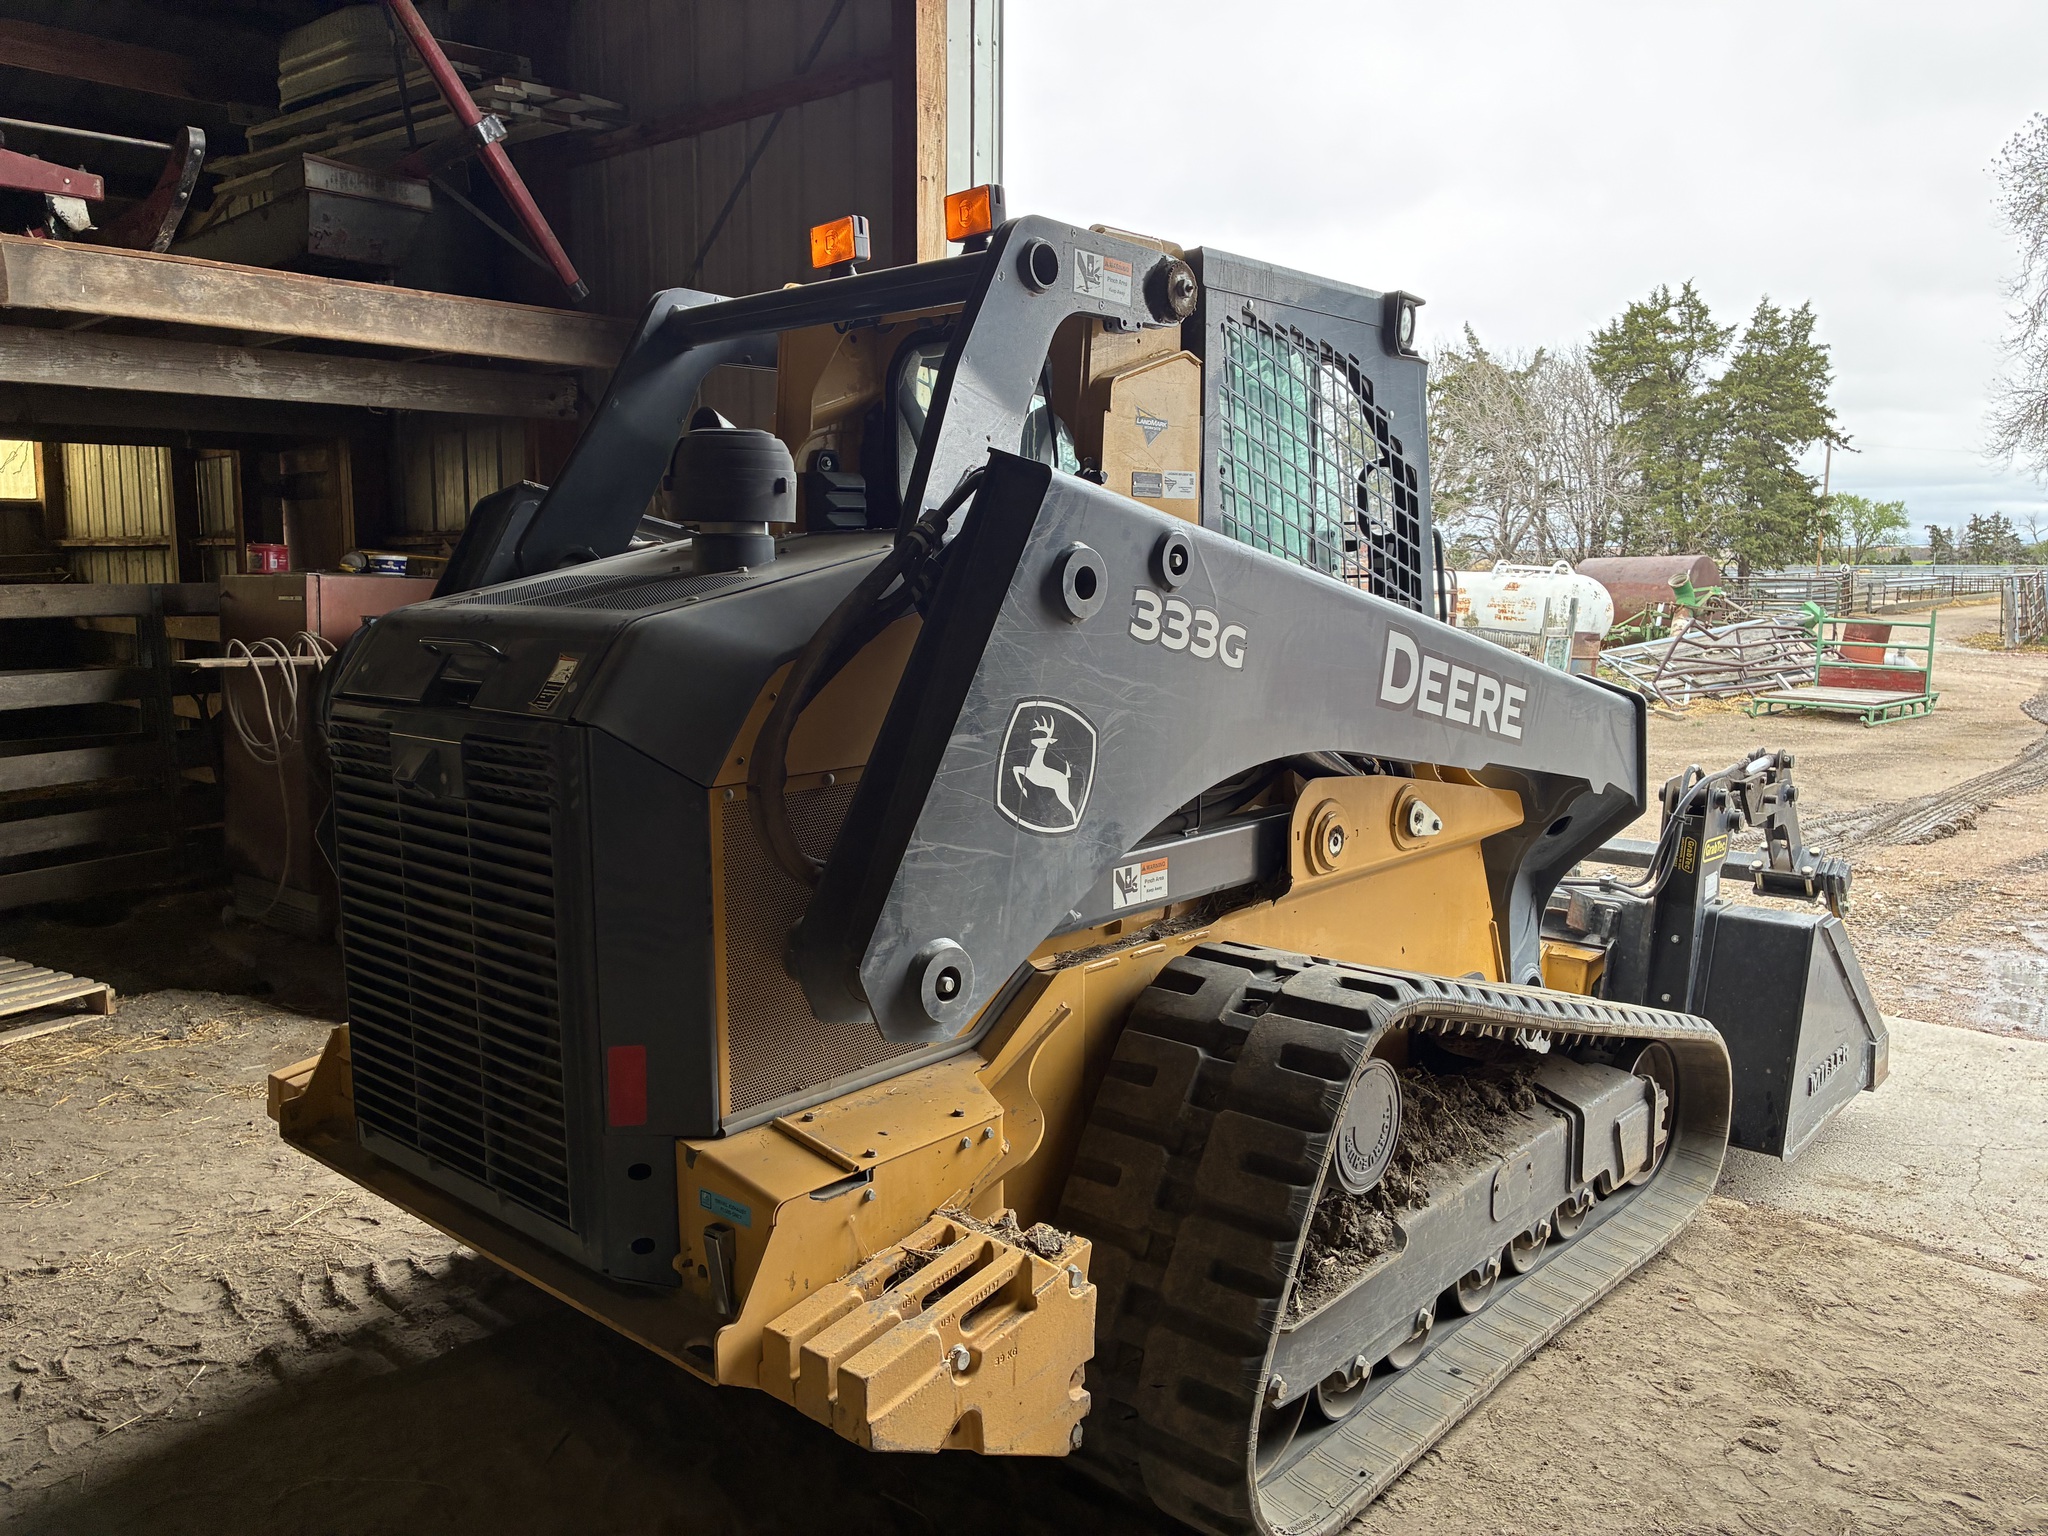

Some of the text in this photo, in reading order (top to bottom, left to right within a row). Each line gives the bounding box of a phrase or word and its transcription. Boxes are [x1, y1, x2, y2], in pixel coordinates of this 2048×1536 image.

[1130, 588, 1248, 670] 333G
[1380, 629, 1528, 740] DEERE
[1684, 840, 1695, 870] GrabTec
[1705, 840, 1726, 857] GrabTec
[1146, 861, 1166, 871] WARNING
[1144, 877, 1156, 885] Pinch
[1807, 1041, 1849, 1097] MILLER
[864, 1277, 880, 1290] USA
[902, 1295, 918, 1310] USA
[940, 1313, 957, 1329] USA
